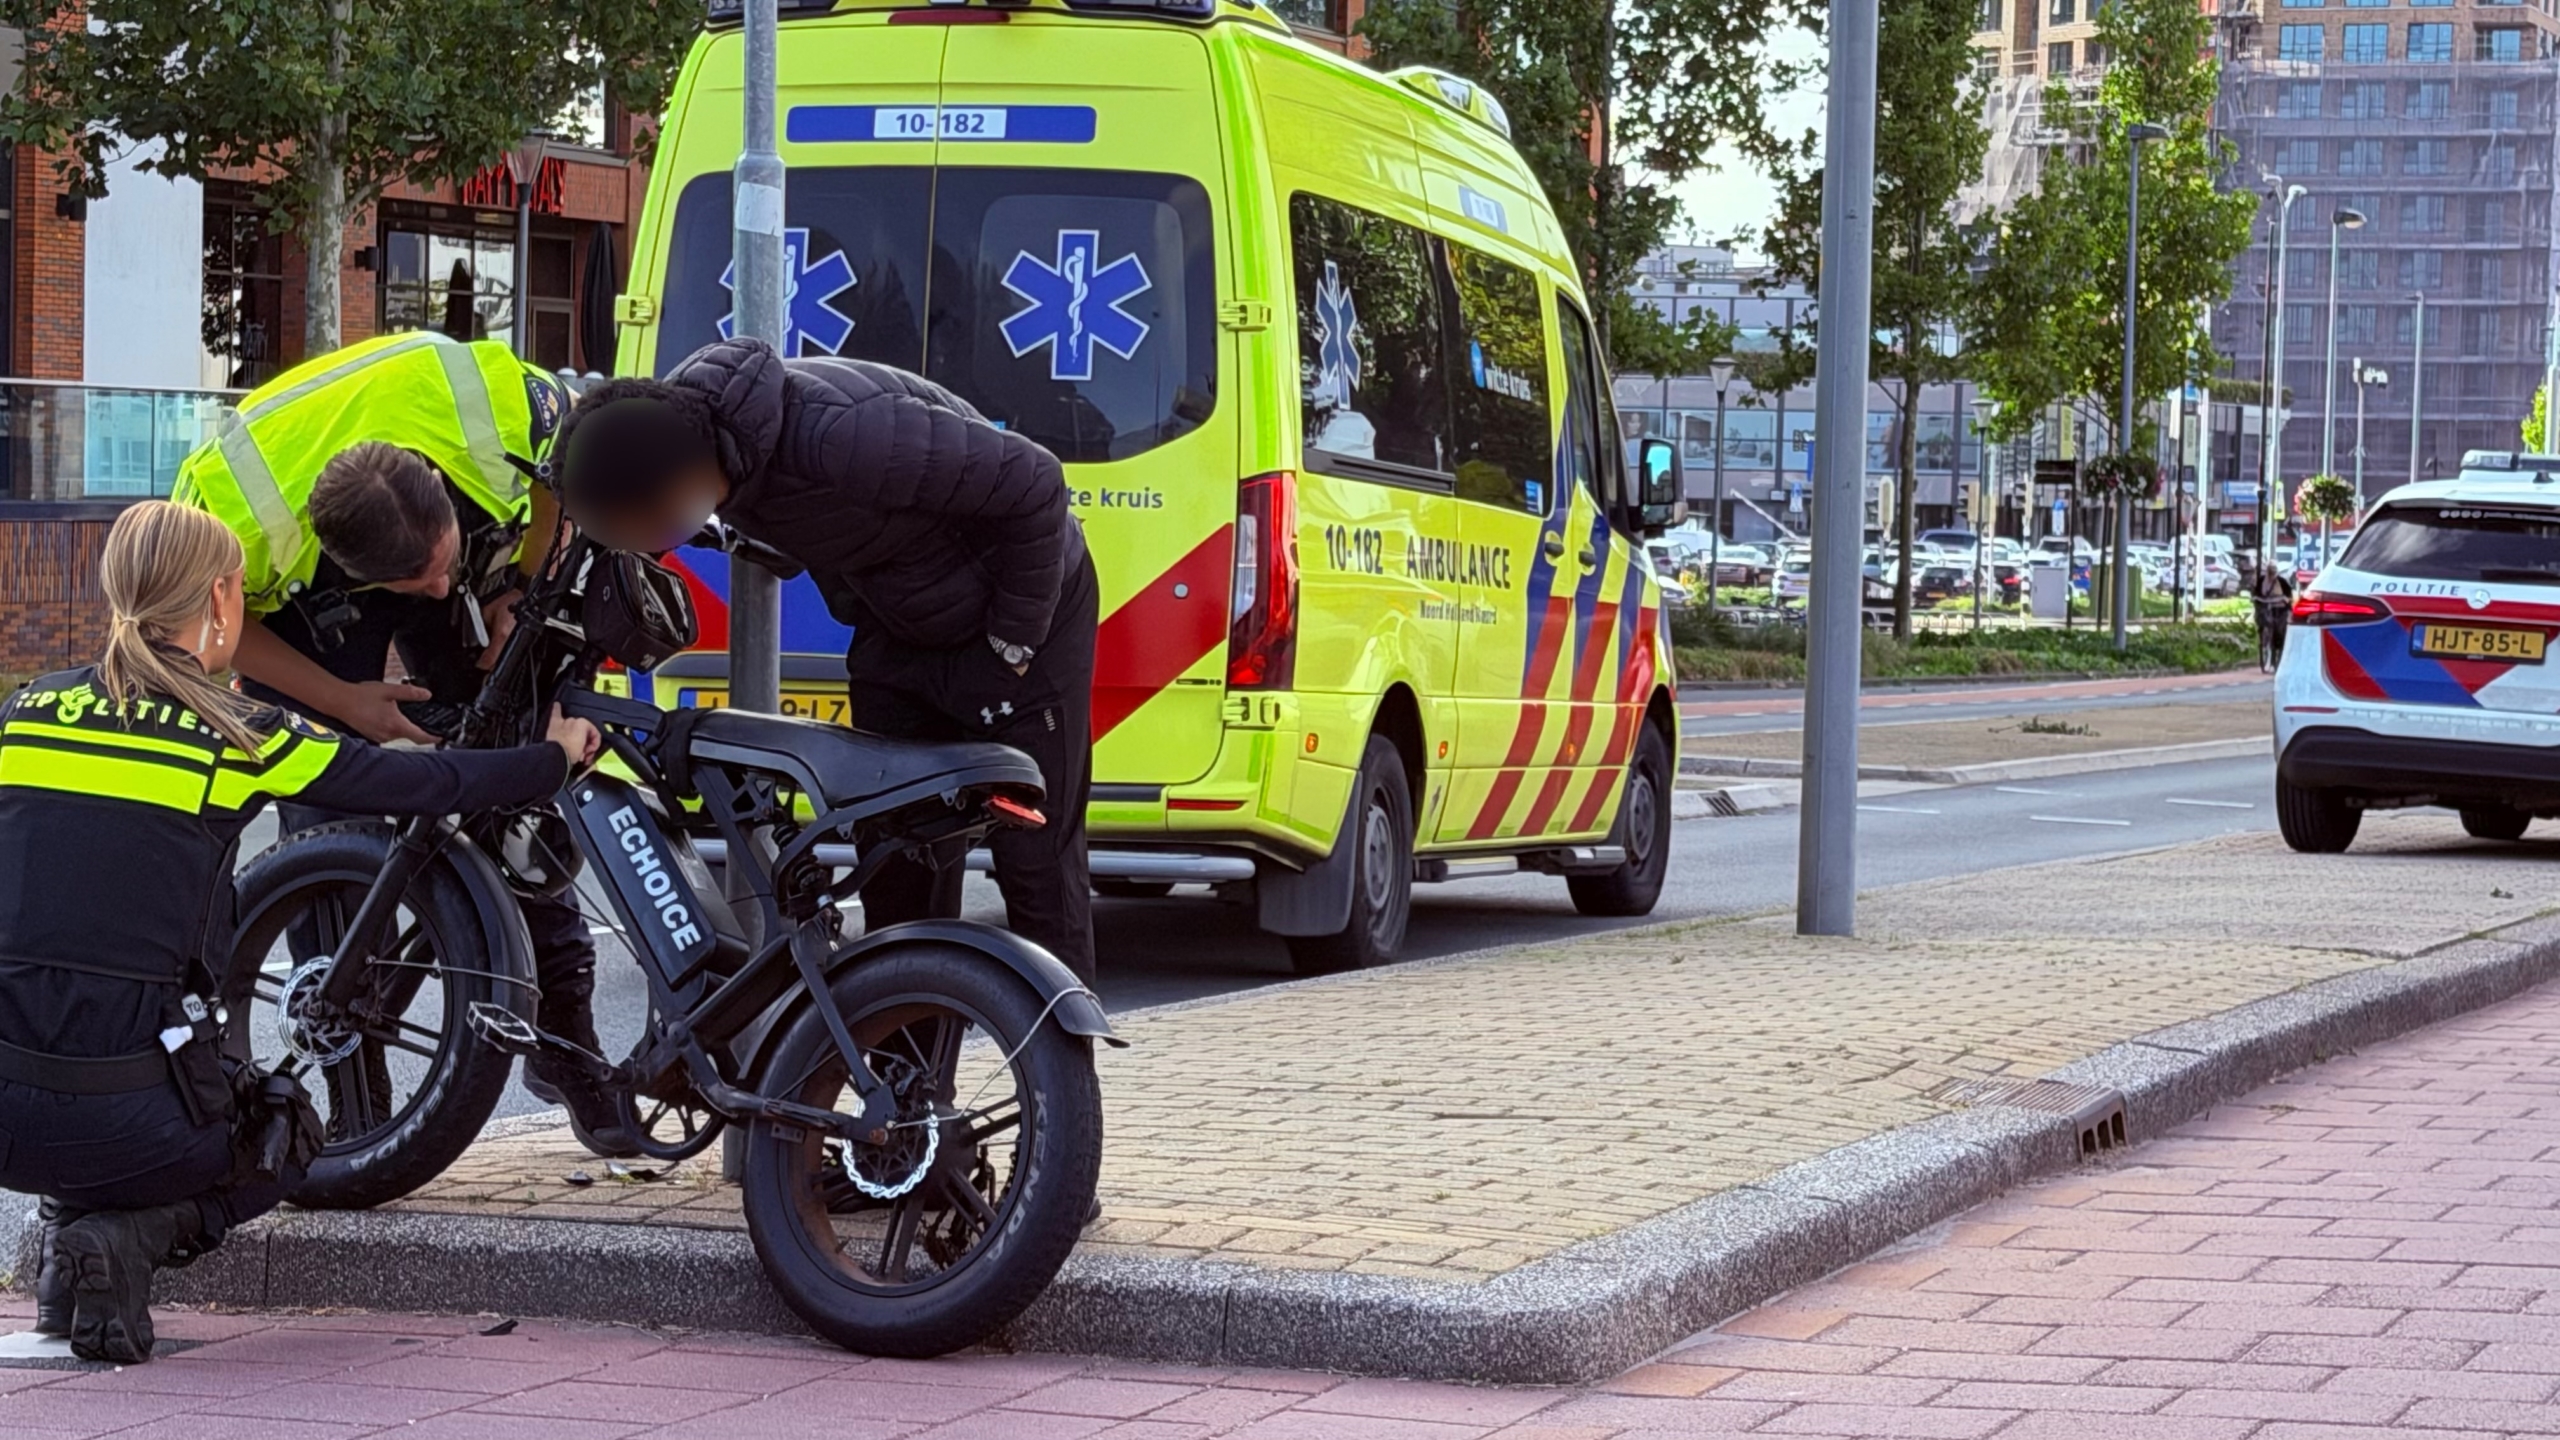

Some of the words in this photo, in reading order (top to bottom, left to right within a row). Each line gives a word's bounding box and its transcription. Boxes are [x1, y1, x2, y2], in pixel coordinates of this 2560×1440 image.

[895, 113, 985, 133] 10-182
[1100, 486, 1163, 509] kruis
[1326, 524, 1383, 575] 10-182
[1406, 535, 1511, 590] AMBULANCE
[2371, 582, 2461, 596] POLITIE
[2431, 629, 2532, 655] HJT-85-L
[608, 805, 701, 952] ECHOICE
[986, 1090, 1048, 1262] KENDA
